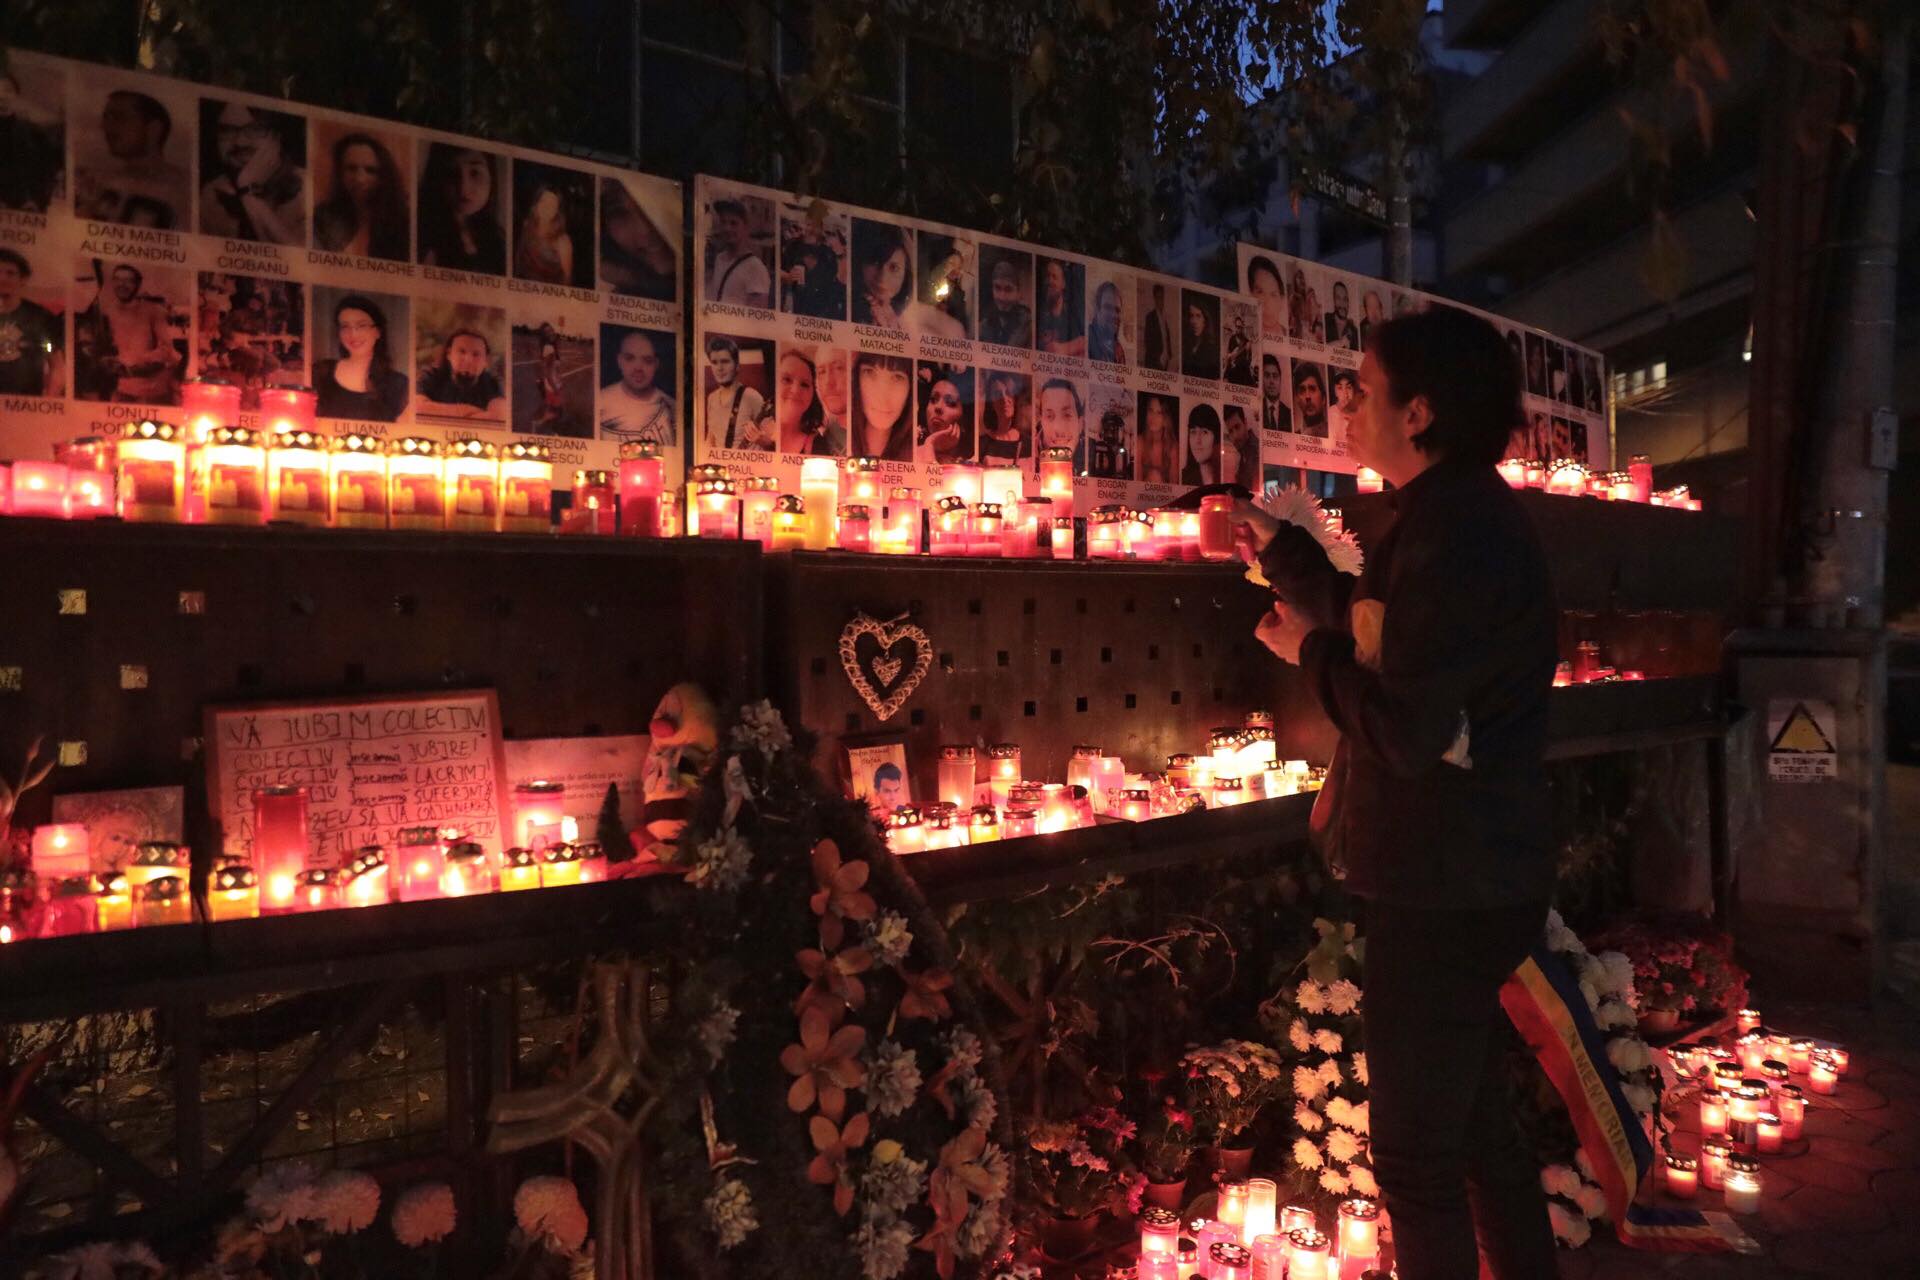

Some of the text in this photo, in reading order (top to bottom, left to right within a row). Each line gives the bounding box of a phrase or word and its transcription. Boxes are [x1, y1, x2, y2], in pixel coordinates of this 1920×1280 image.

[87, 223, 180, 247] DAN MATEI
[81, 239, 187, 264] ALEXANDRU
[224, 240, 281, 260] DANIEL
[217, 255, 290, 276] CIOBANU
[307, 250, 416, 278] DIANA ENACHE
[423, 267, 501, 290] ELENA NITU
[507, 282, 600, 304] ELSA ANA ALBU
[609, 295, 669, 314] MADALINA
[704, 302, 777, 322] ADRIAN POPA
[606, 308, 672, 328] STRUGARU
[794, 316, 834, 331] ADRIAN
[794, 328, 834, 344] RUGINA
[854, 325, 911, 342] ALEXANDRA
[860, 338, 905, 354] MATACHE
[920, 335, 973, 351] ALEXANDRA
[981, 343, 1031, 360] ALEXANDRU
[919, 347, 974, 363] RADULESCU
[991, 357, 1022, 370] ALIMAN
[1038, 353, 1085, 368] ALEXANDRU
[1090, 361, 1133, 376] ALEXANDRU
[1139, 369, 1178, 384] ALEXANDRU
[107, 405, 160, 422] IONUT
[708, 449, 774, 464] ALEXANDRU
[727, 464, 754, 475] PAUL
[886, 462, 917, 474] ELENA
[1097, 479, 1128, 490] BOGDAN
[1575, 1054, 1635, 1171] MEMORIAM
